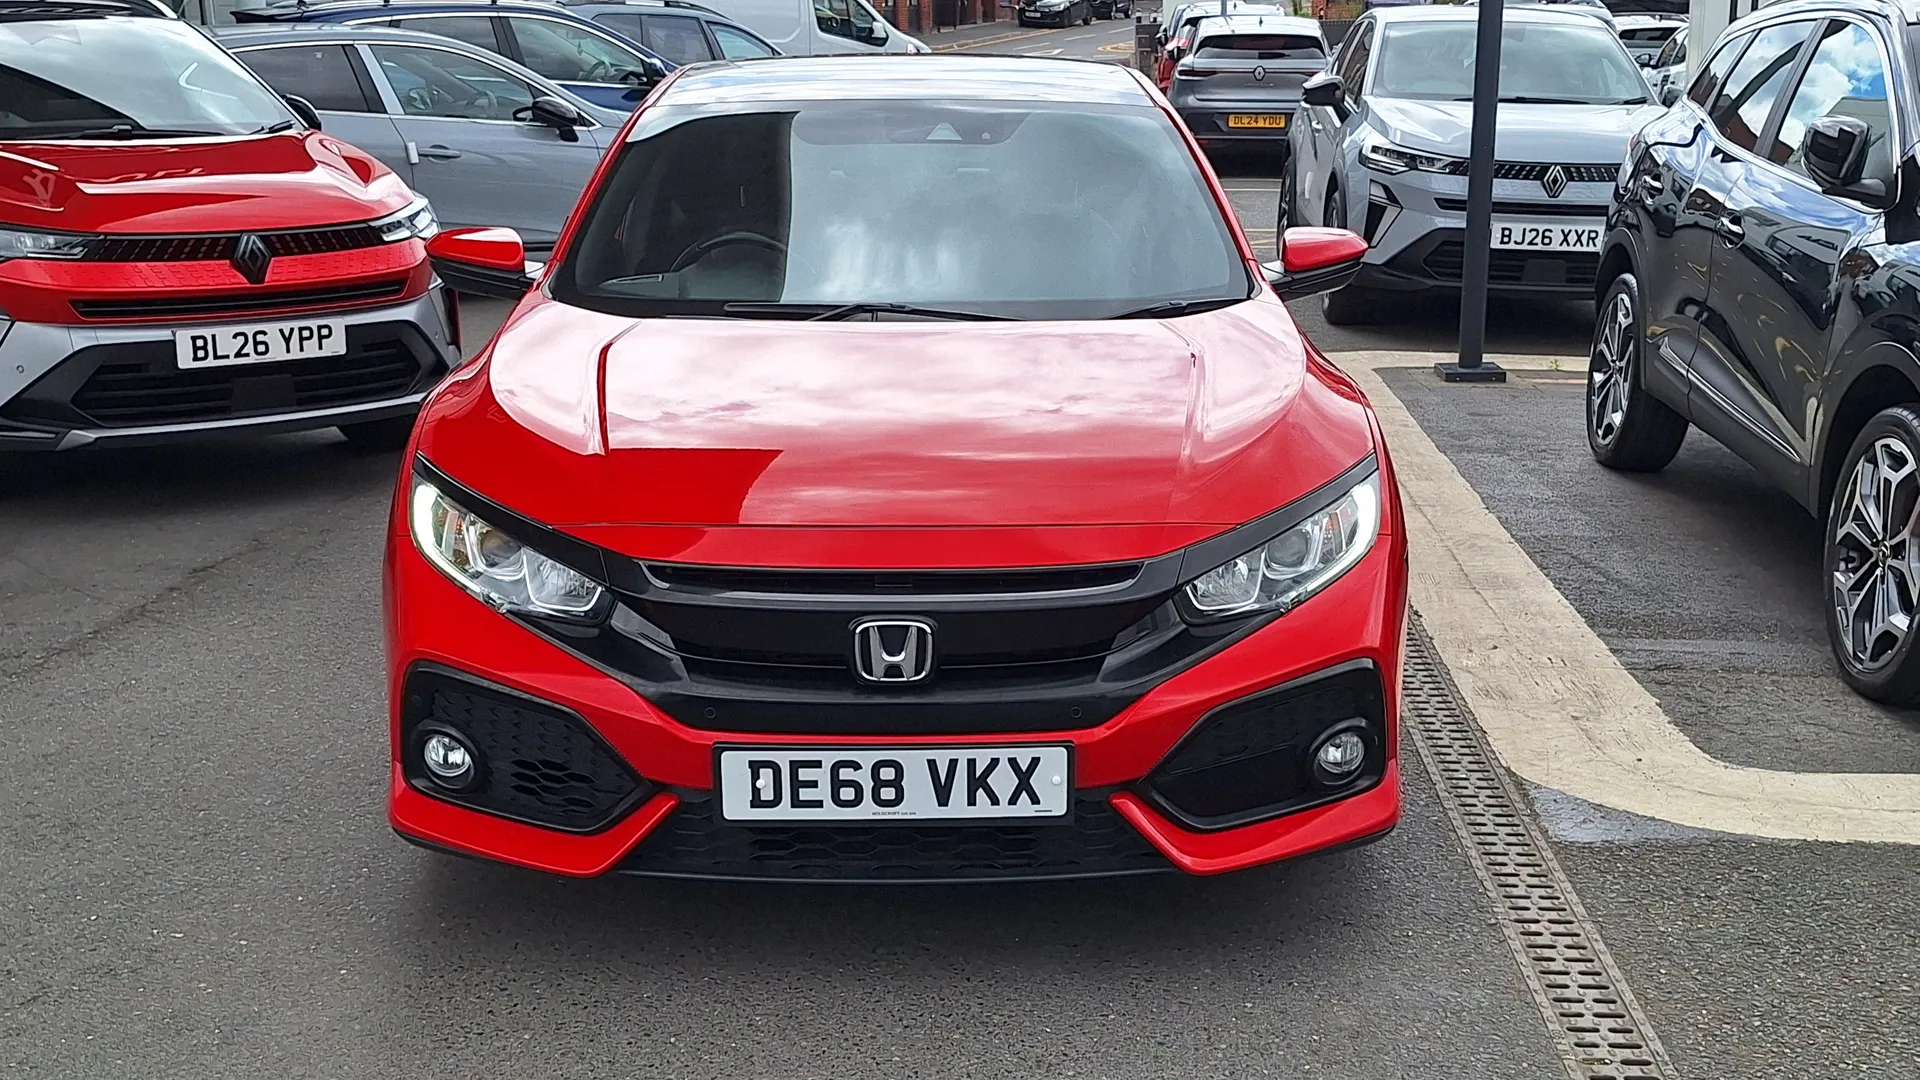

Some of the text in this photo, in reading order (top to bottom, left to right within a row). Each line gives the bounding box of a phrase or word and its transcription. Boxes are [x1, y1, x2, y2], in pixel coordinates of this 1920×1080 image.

[1233, 116, 1282, 126] DL24 YDU
[1499, 227, 1599, 248] BJ26 XXR
[190, 324, 333, 362] BL26 YPP
[748, 756, 1042, 809] DE68 VKX
